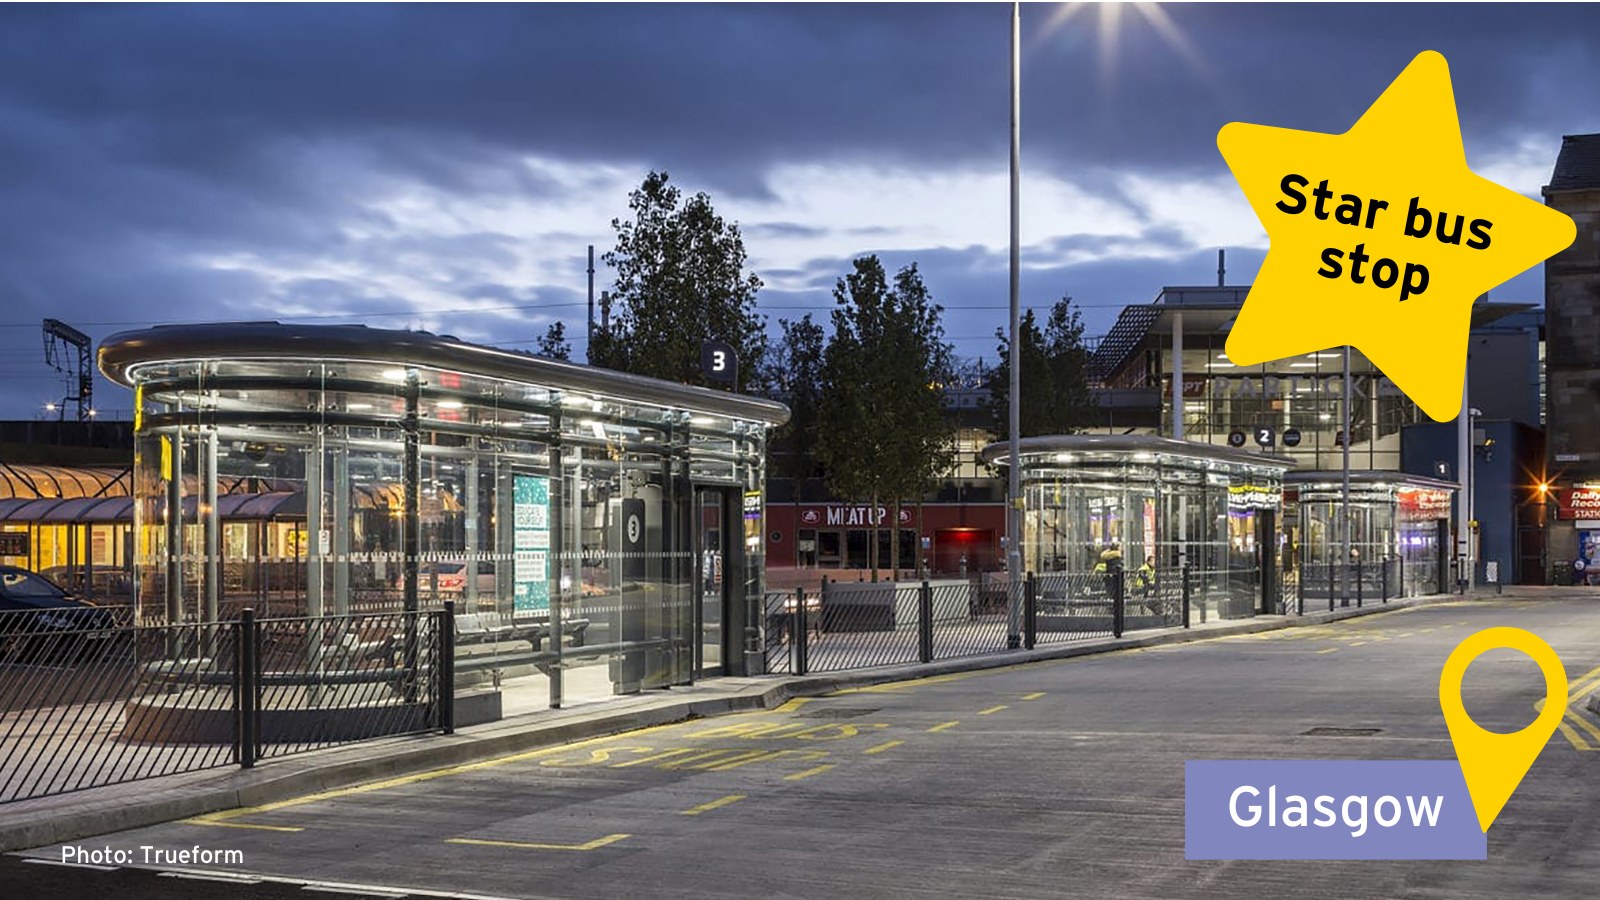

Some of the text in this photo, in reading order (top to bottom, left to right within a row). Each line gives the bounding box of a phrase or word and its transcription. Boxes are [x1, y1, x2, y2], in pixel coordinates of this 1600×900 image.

[712, 351, 725, 371] 3
[1259, 429, 1269, 442] 2
[1439, 464, 1445, 473] 1
[631, 521, 637, 536] 3
